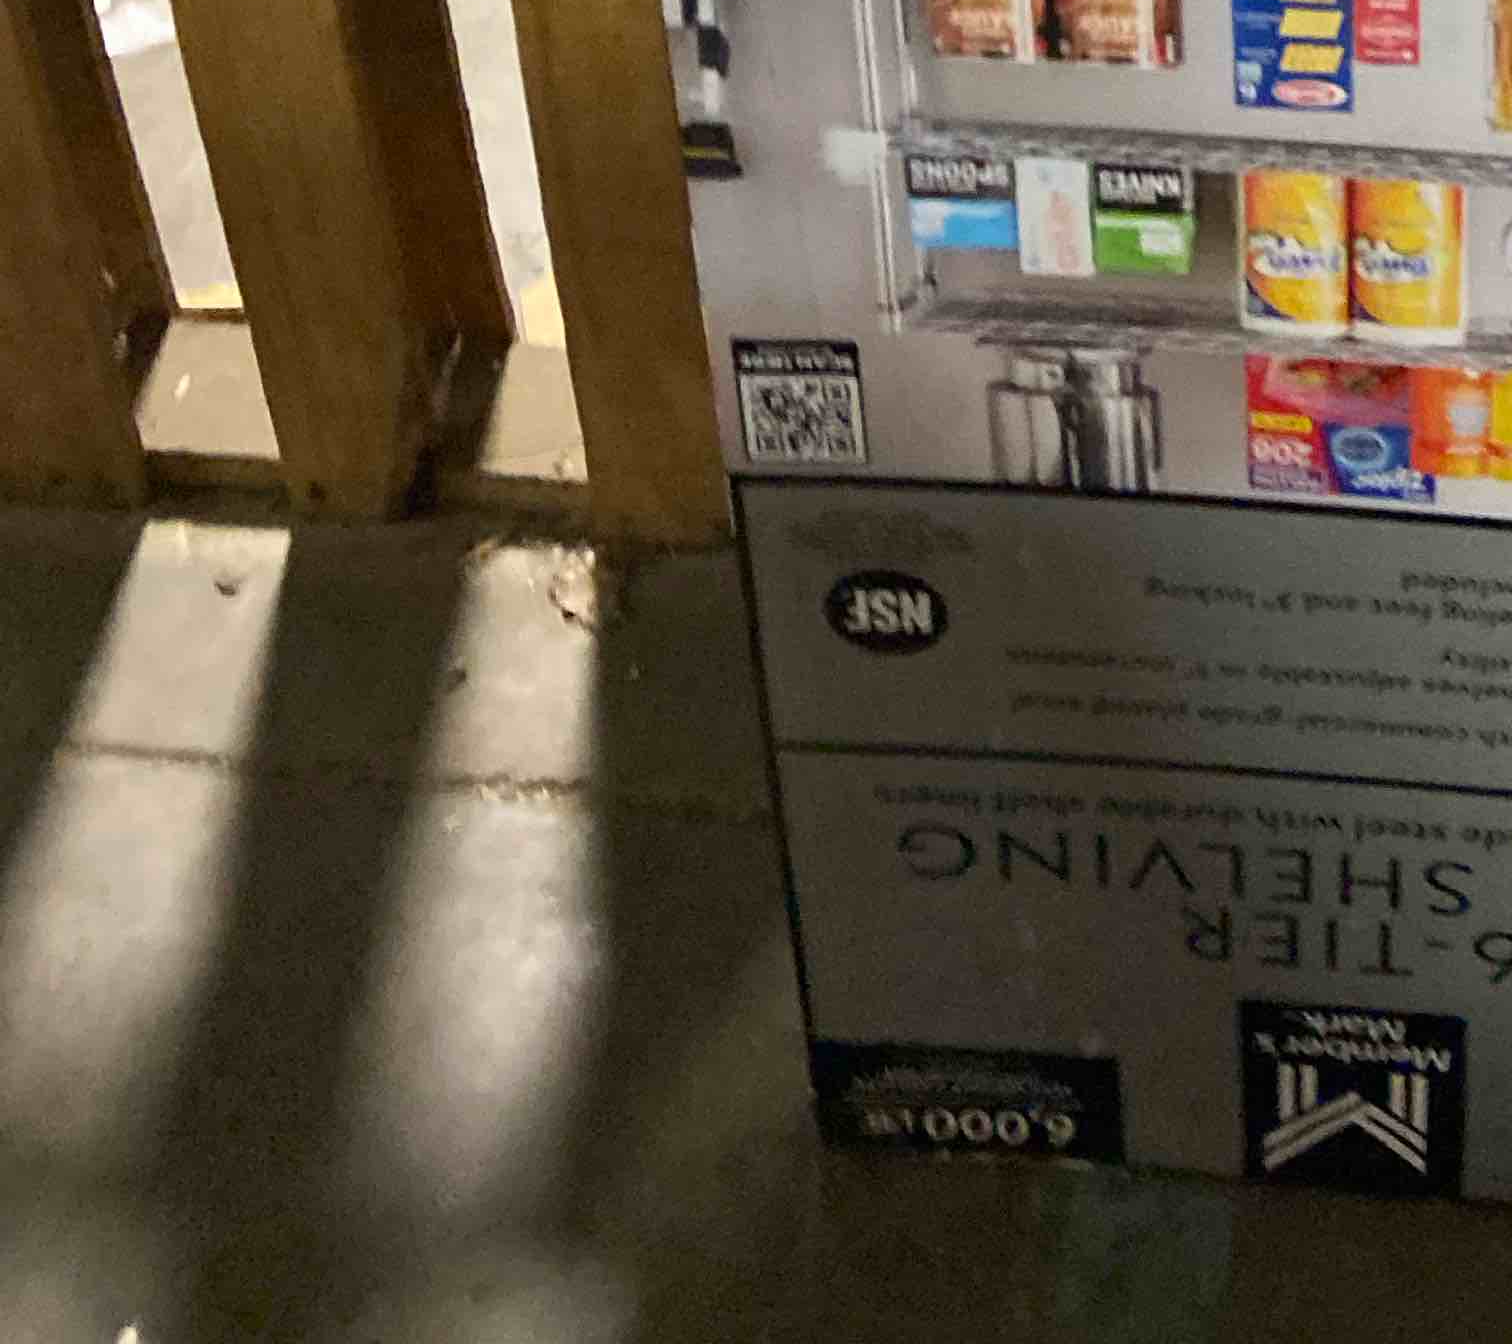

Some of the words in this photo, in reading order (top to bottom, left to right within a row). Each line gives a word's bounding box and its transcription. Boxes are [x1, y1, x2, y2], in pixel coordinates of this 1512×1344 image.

[843, 588, 933, 638] NSF
[1370, 597, 1433, 624] feet
[1254, 808, 1342, 835] with
[1353, 815, 1446, 842] steel
[897, 822, 1473, 917] SHELVING
[1300, 1010, 1408, 1042] Mark
[1252, 1031, 1452, 1074] Member's
[922, 1103, 1077, 1148] 6,000
